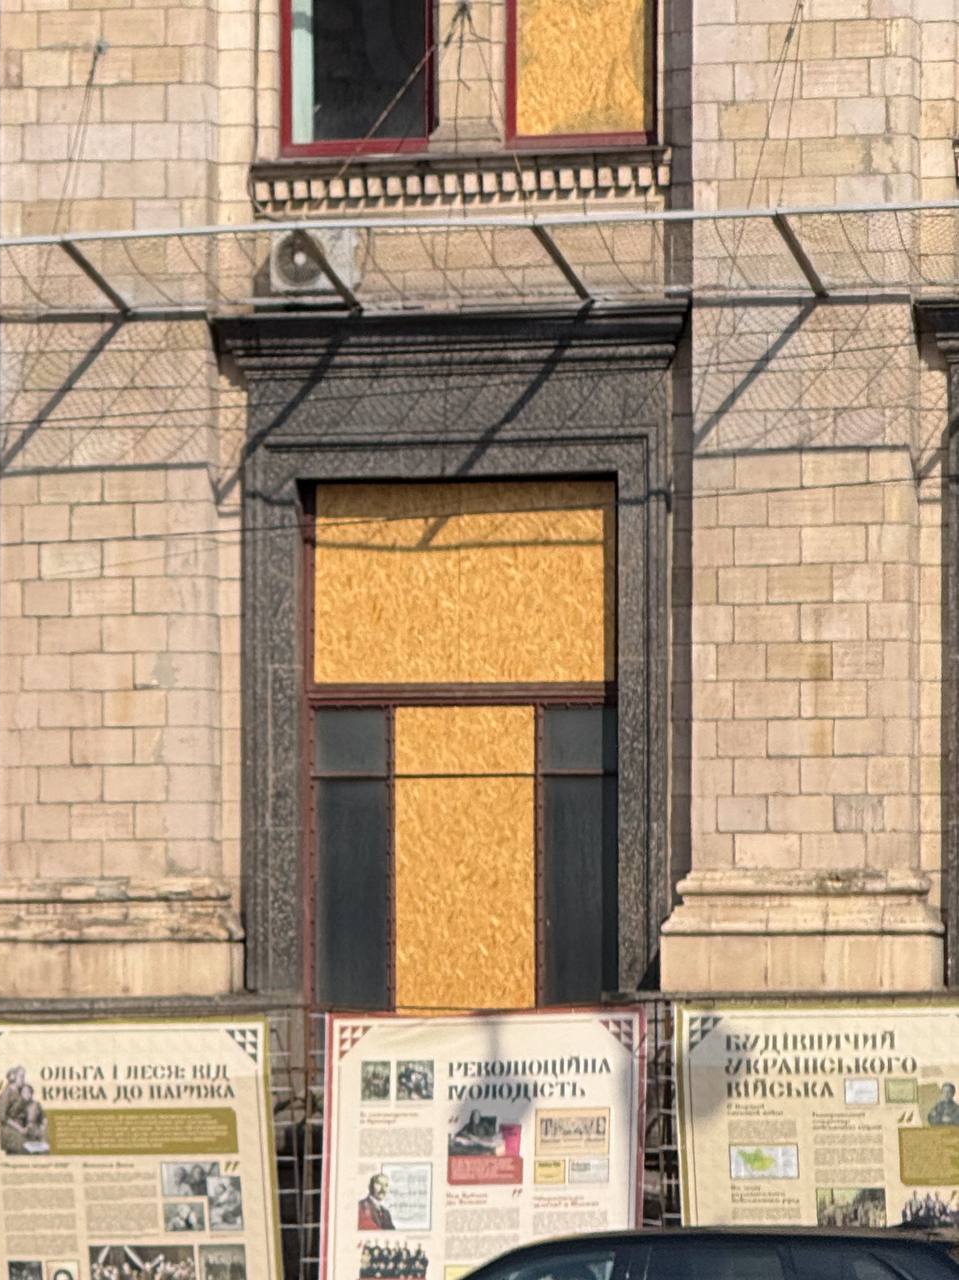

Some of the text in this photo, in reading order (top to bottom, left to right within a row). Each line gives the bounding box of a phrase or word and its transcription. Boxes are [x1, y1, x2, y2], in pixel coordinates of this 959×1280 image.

[725, 1031, 896, 1056] БУДІВНИЧИЙ
[40, 1065, 105, 1081] ОЛЬГА
[112, 1064, 118, 1080] І
[192, 1062, 230, 1082] ВІД
[448, 1056, 612, 1079] РЕВОЛЮЦІЙНА
[725, 1055, 918, 1075] УКРАЇНСЬКОГО
[42, 1084, 236, 1103] КИЄВА ДО ПАРИЖА
[448, 1080, 586, 1103] МОЛОДІСТЬ
[727, 1076, 834, 1098] ВІЙСЬКА
